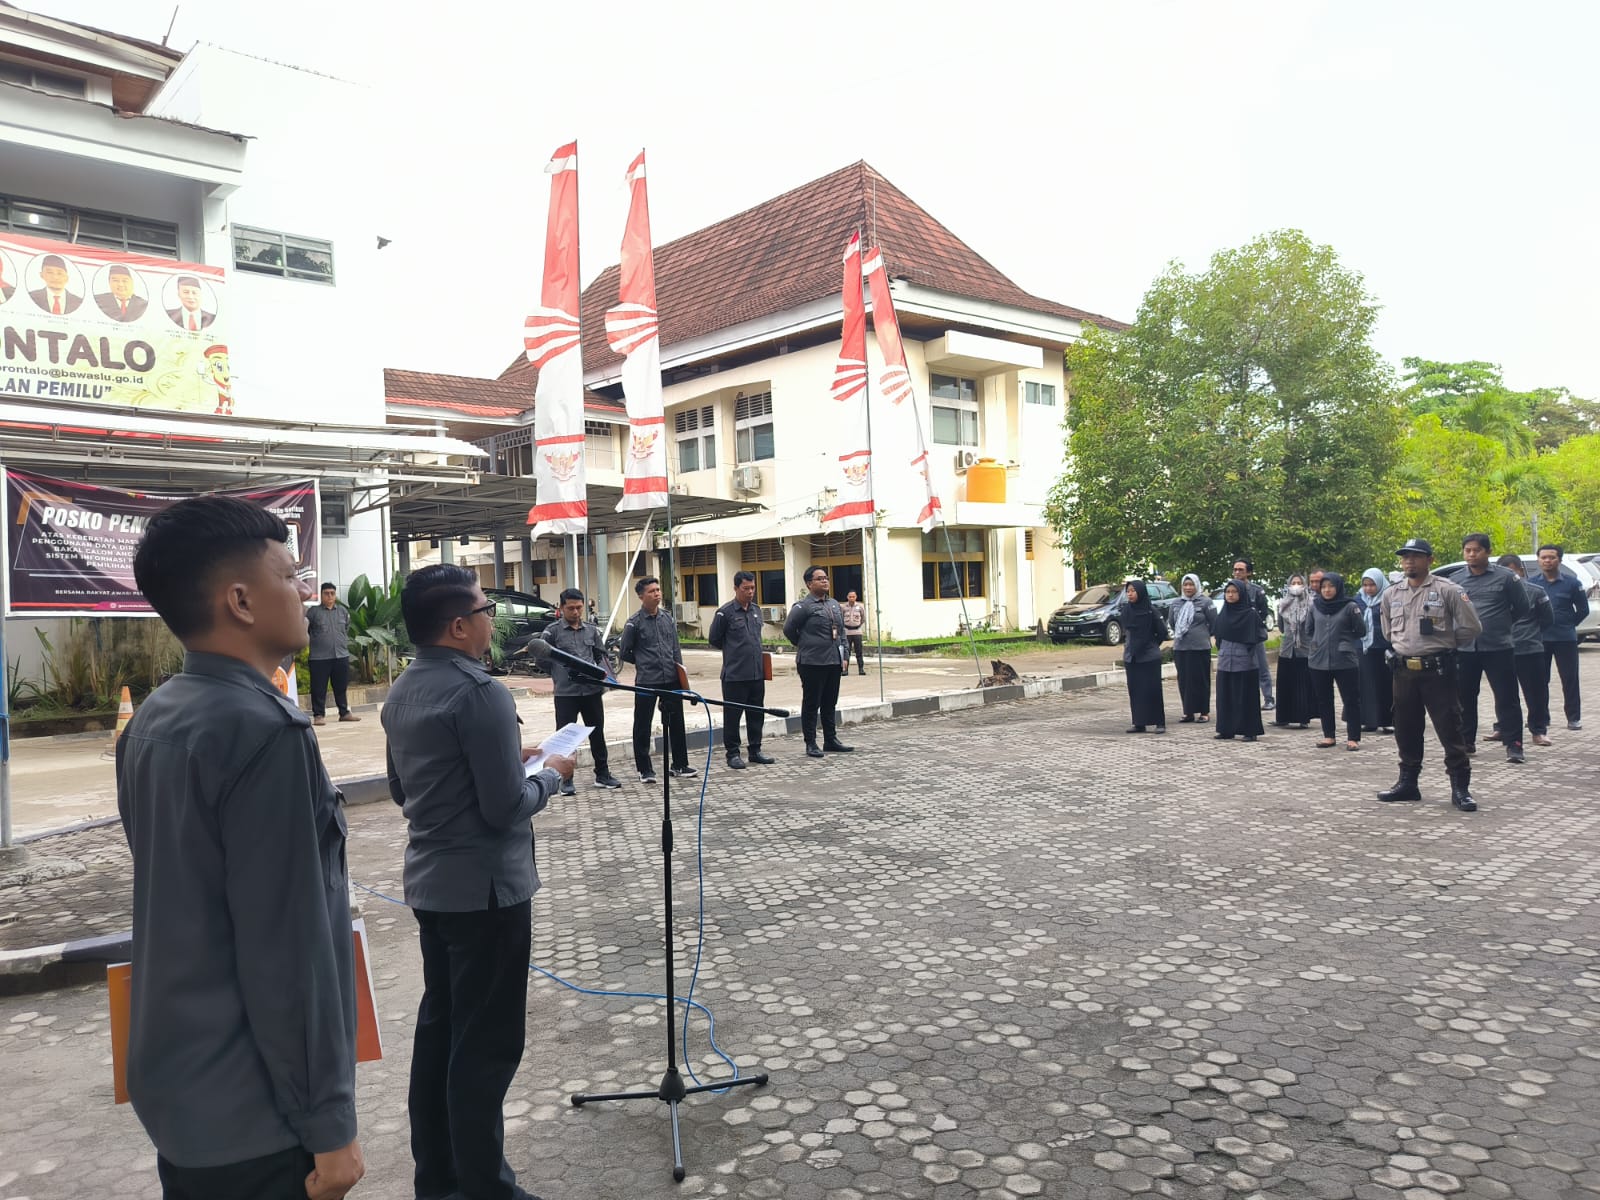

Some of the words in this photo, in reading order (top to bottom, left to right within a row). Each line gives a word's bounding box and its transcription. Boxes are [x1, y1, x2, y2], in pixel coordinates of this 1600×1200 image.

[0, 326, 156, 373] NTALO
[41, 506, 103, 530] POSKO
[32, 538, 92, 547] PENGGUNAAN
[41, 531, 64, 539] ATAS
[66, 534, 115, 543] KEBERATAN
[45, 552, 78, 560] SISTEM
[80, 555, 126, 563] INFORMASI
[86, 561, 131, 569] PEMILIHAN
